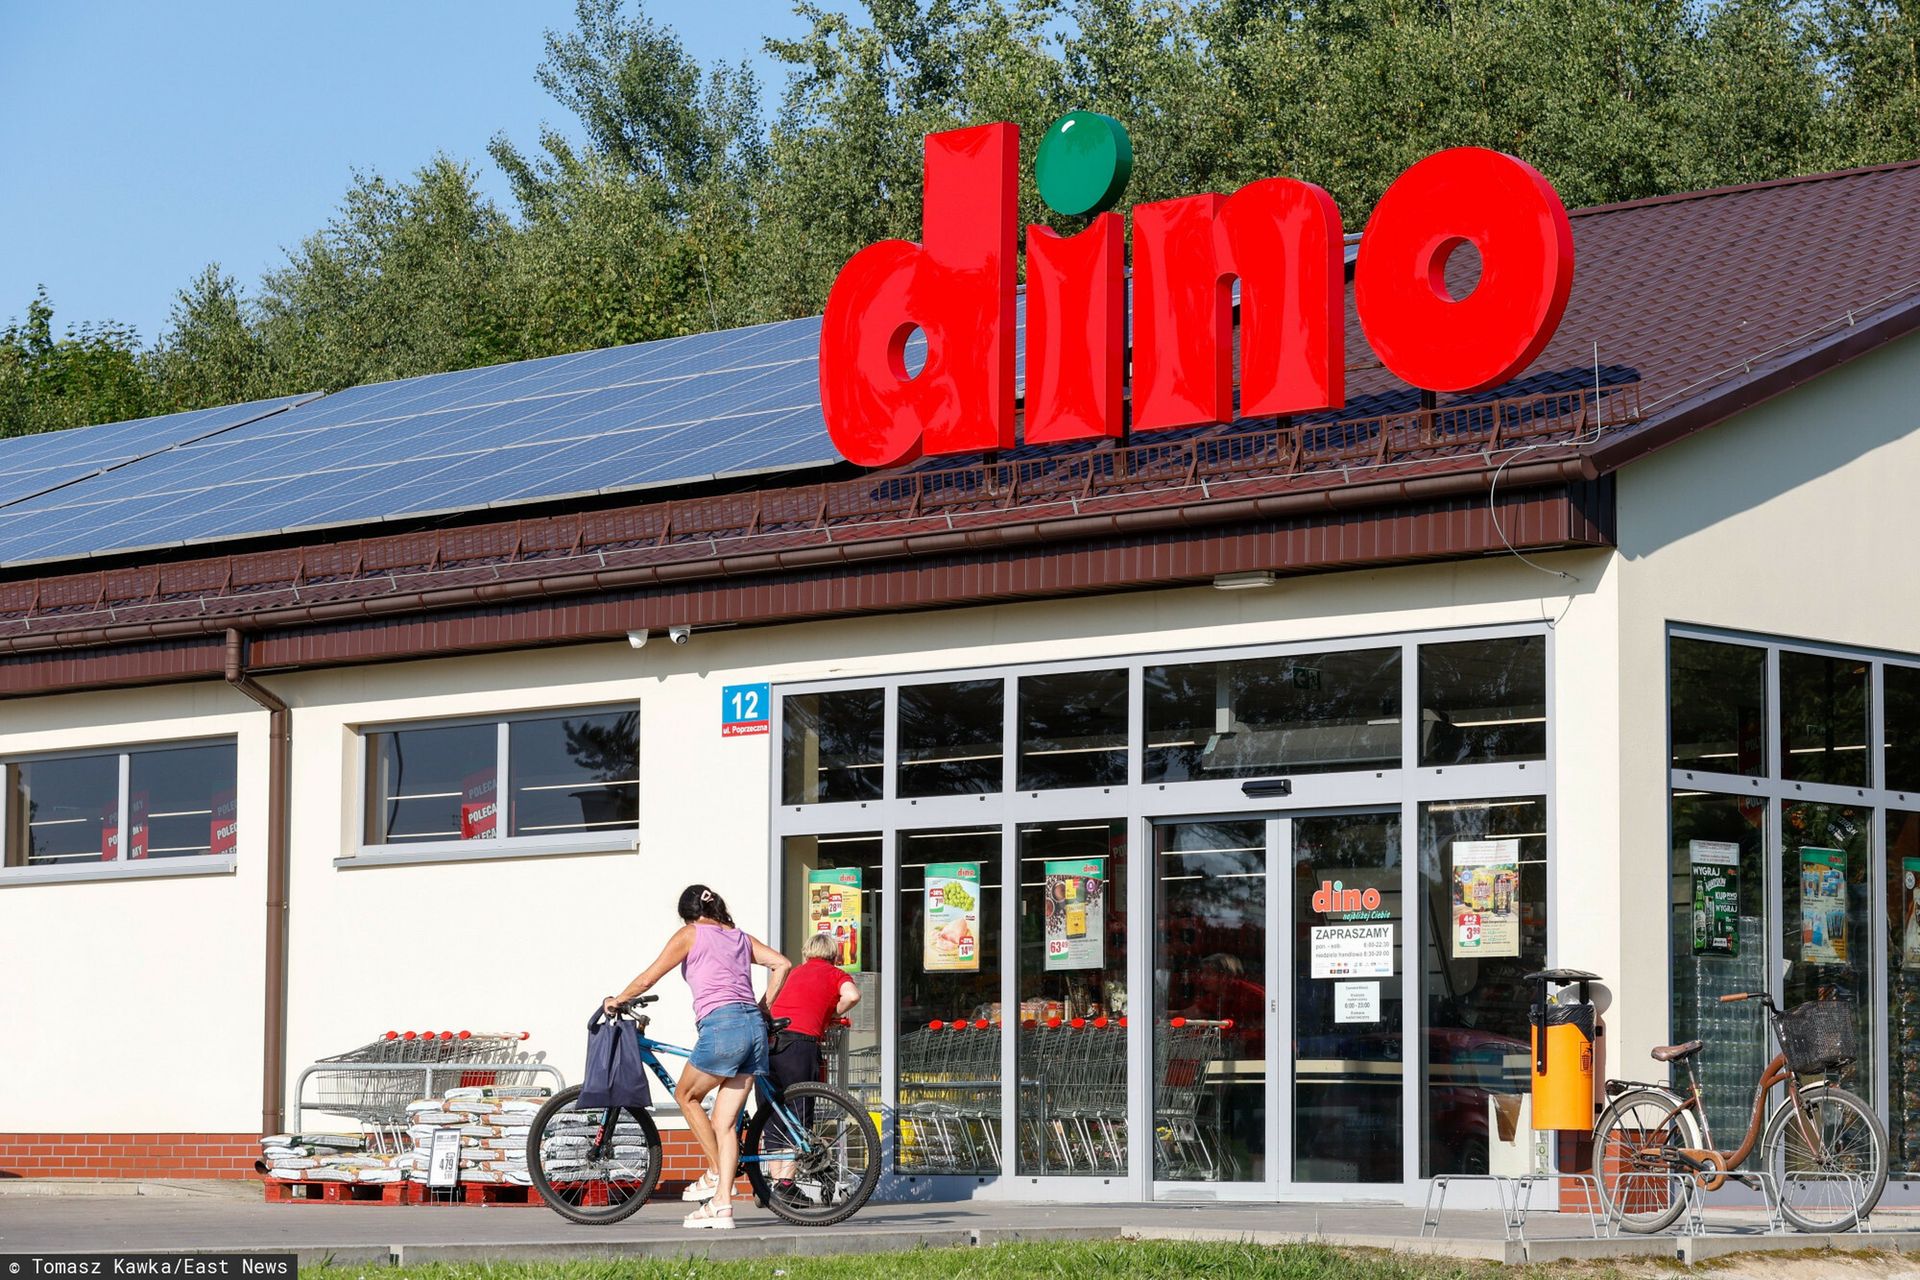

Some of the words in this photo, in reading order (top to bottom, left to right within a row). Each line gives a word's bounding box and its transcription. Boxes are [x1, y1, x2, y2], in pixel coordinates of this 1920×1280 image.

[820, 110, 1575, 469] dino
[732, 690, 759, 721] 12
[468, 778, 497, 800] POLECA
[467, 802, 497, 825] POLECA
[1692, 866, 1721, 877] WYGRAJ
[1312, 880, 1381, 913] dino
[1315, 927, 1389, 940] ZAPRASZAMY
